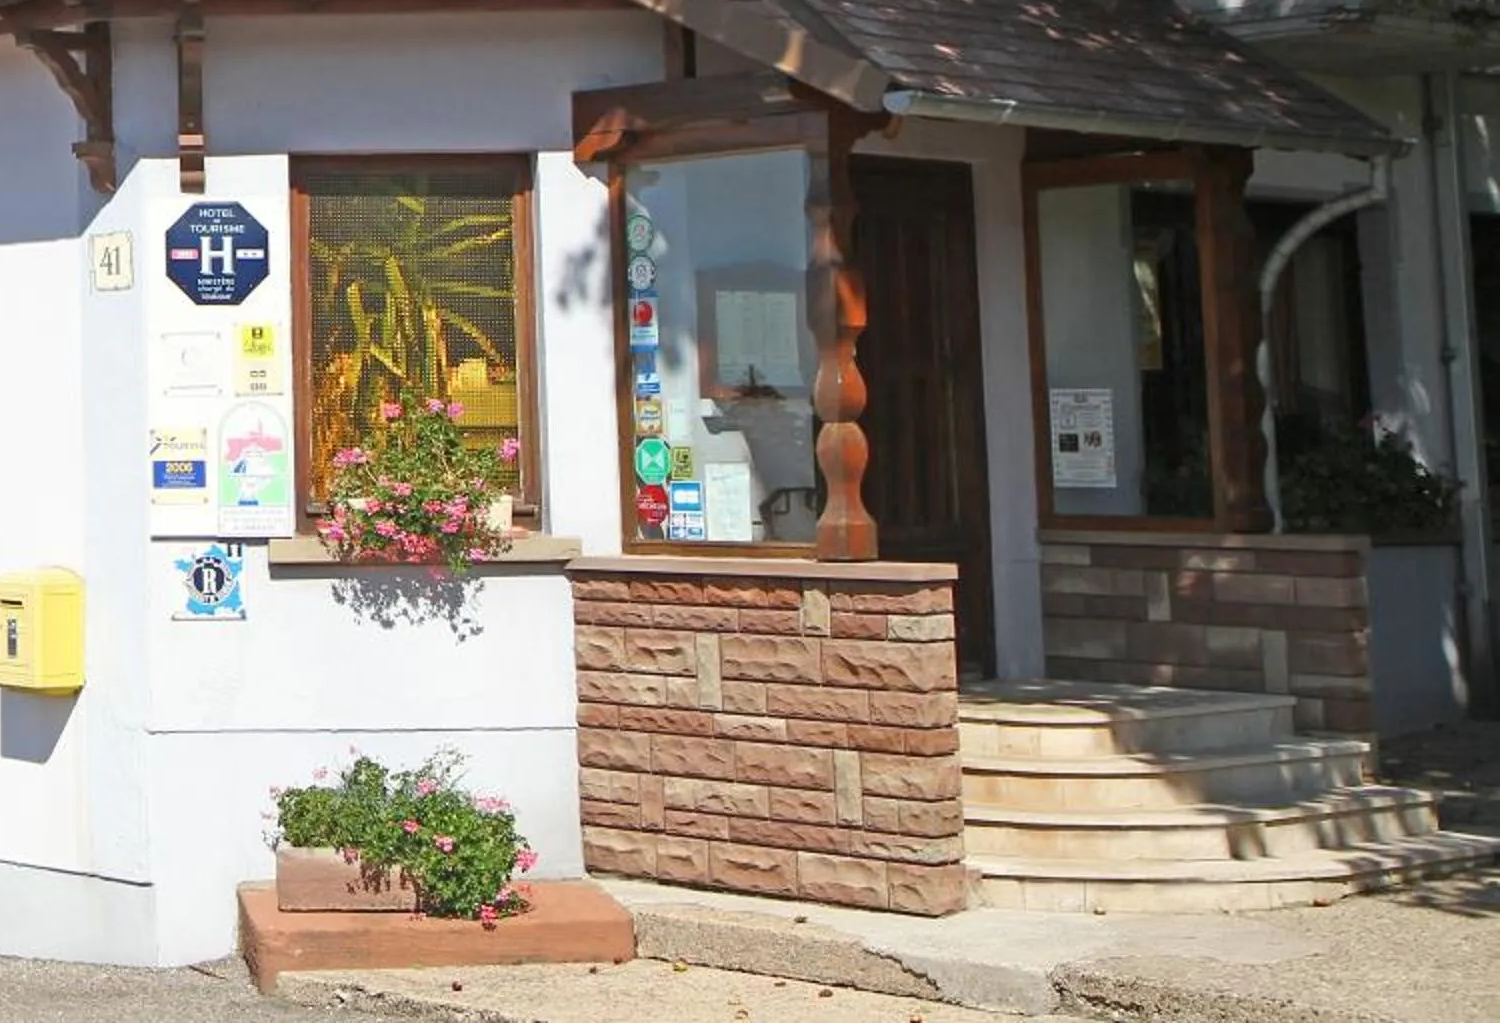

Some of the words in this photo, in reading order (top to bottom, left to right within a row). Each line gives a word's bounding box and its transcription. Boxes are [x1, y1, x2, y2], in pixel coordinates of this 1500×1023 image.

[190, 224, 245, 234] TOURISME
[99, 246, 121, 276] 41
[199, 236, 236, 276] H
